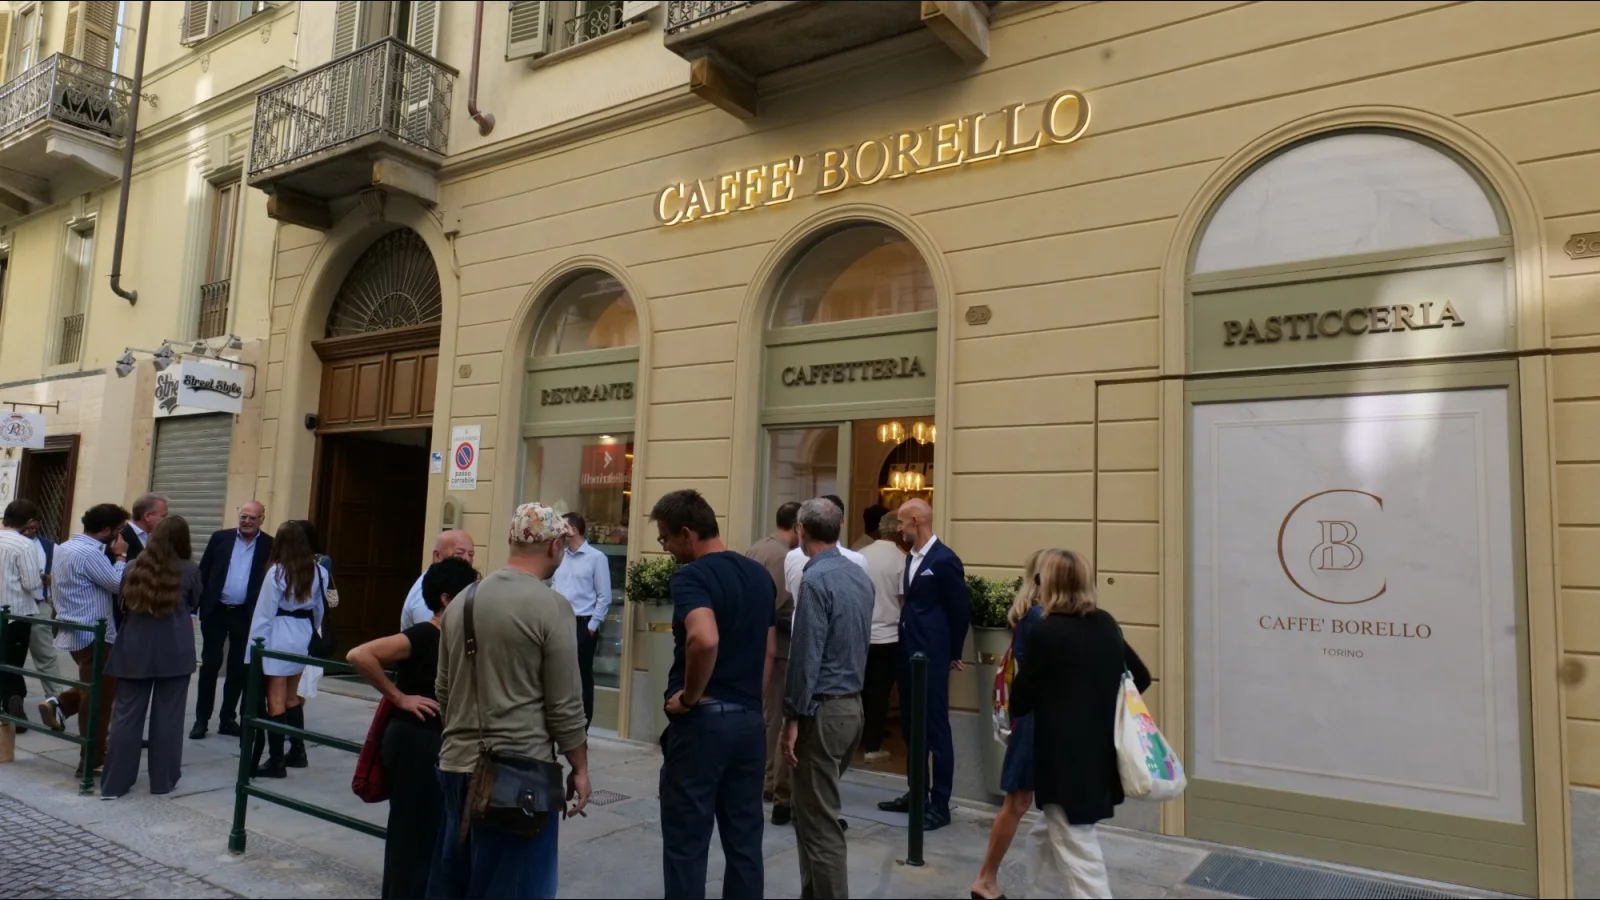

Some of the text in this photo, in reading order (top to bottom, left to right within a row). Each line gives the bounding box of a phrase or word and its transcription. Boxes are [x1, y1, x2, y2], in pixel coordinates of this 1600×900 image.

[653, 89, 1091, 226] CAFFE' BORELLO
[1223, 299, 1465, 347] PASTICCERIA
[781, 356, 925, 387] CAFFETTERIA
[183, 374, 242, 395] Street Style
[540, 381, 634, 406] RISTORANTE
[1258, 615, 1432, 639] CAFFE' BORELLO
[1322, 648, 1364, 658] TORINO
